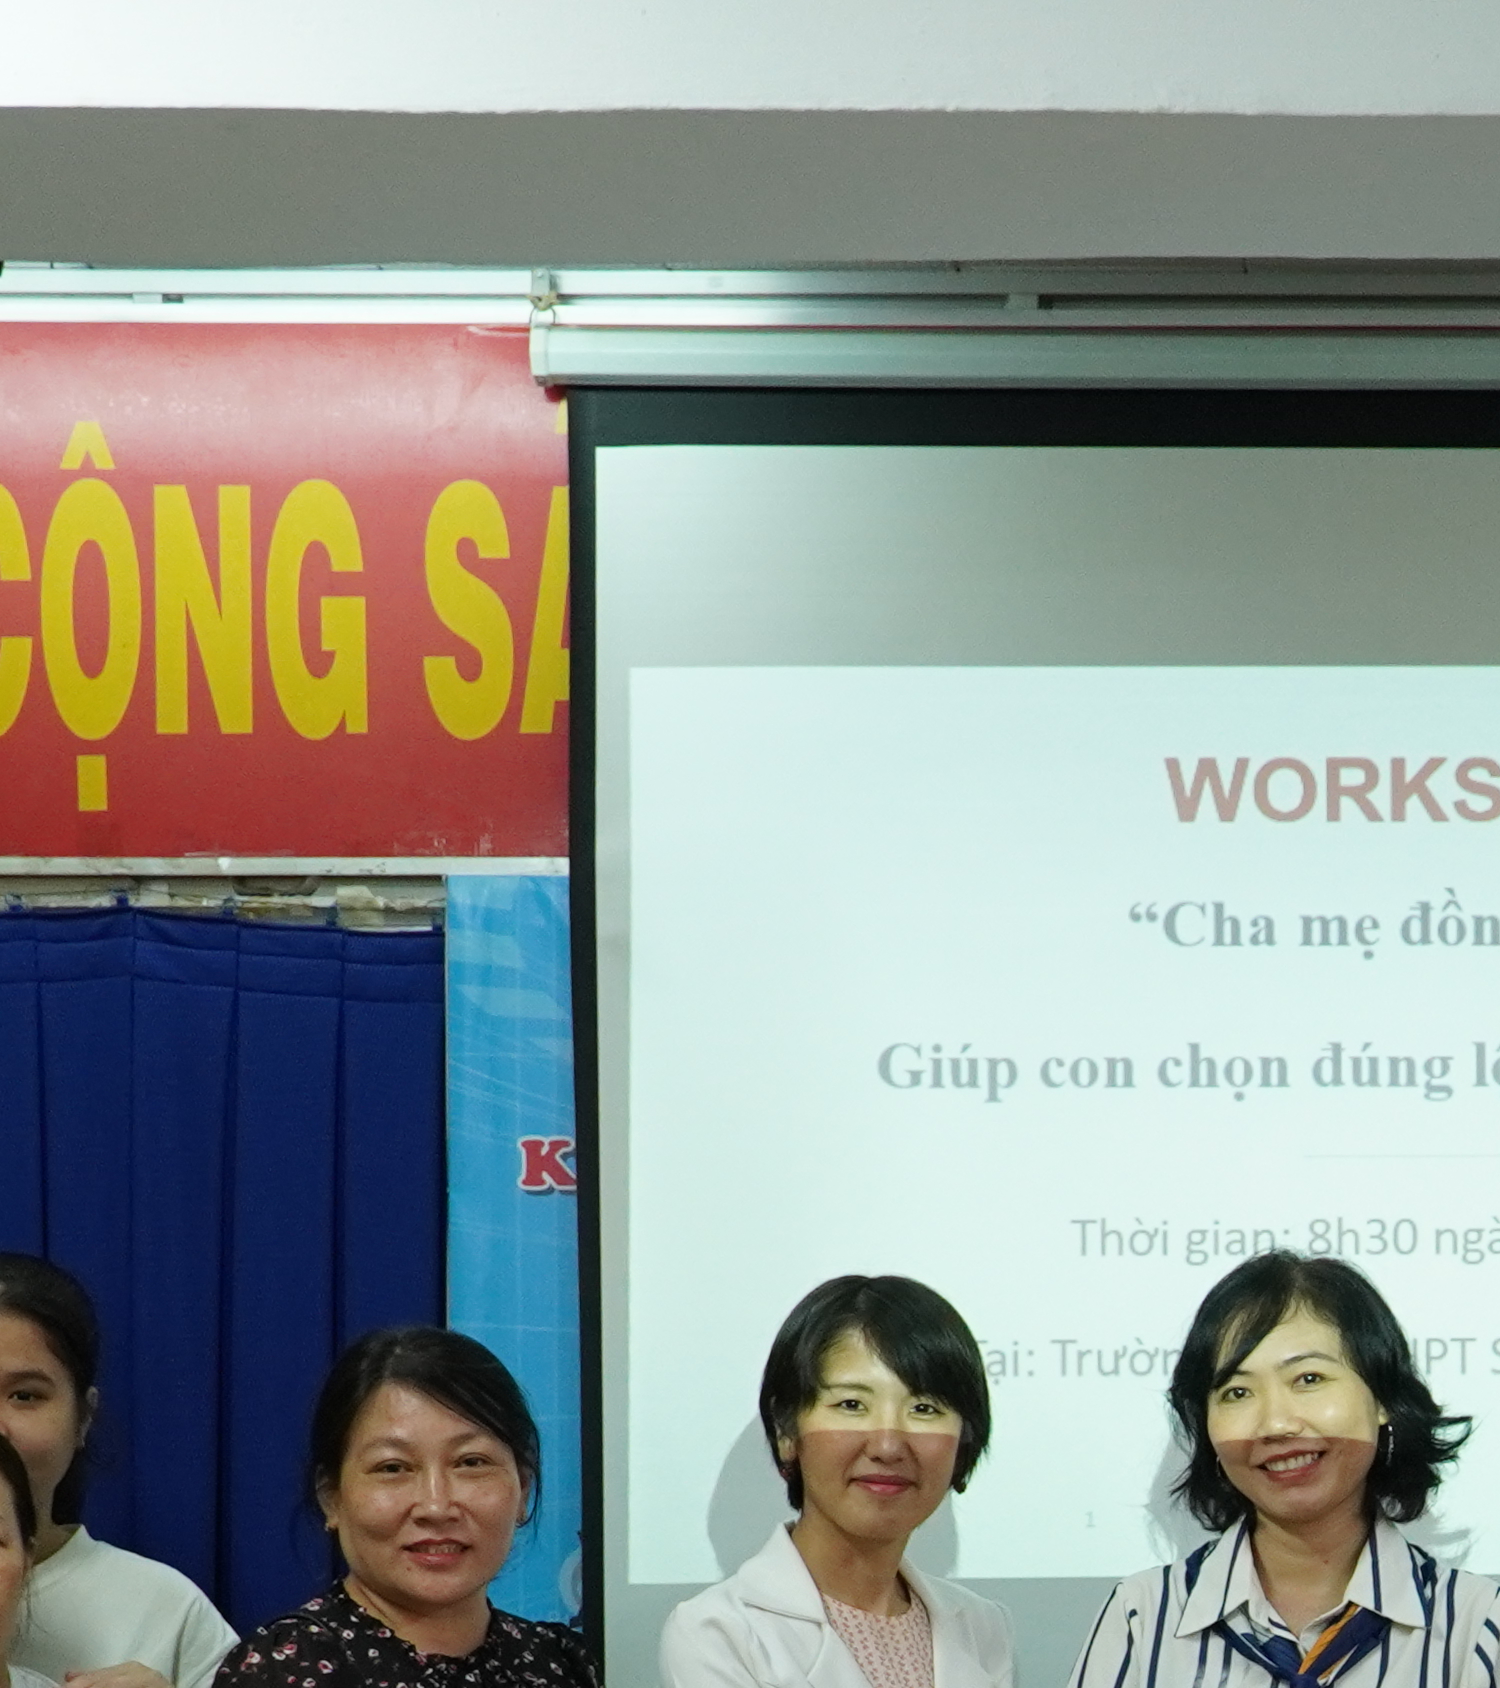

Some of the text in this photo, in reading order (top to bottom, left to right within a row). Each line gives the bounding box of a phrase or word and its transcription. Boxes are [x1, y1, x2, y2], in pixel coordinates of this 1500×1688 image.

[423, 398, 570, 741] S
[1129, 901, 1277, 947] “Cha
[1299, 914, 1381, 960] mẹ
[877, 1042, 1018, 1103] Giúp
[1039, 1056, 1135, 1088] con
[1157, 1042, 1290, 1102] chọn
[1311, 1042, 1454, 1101] đúng
[1071, 1217, 1169, 1256] Thời
[1308, 1216, 1419, 1256] 8h30
[1085, 1510, 1097, 1529] 1
